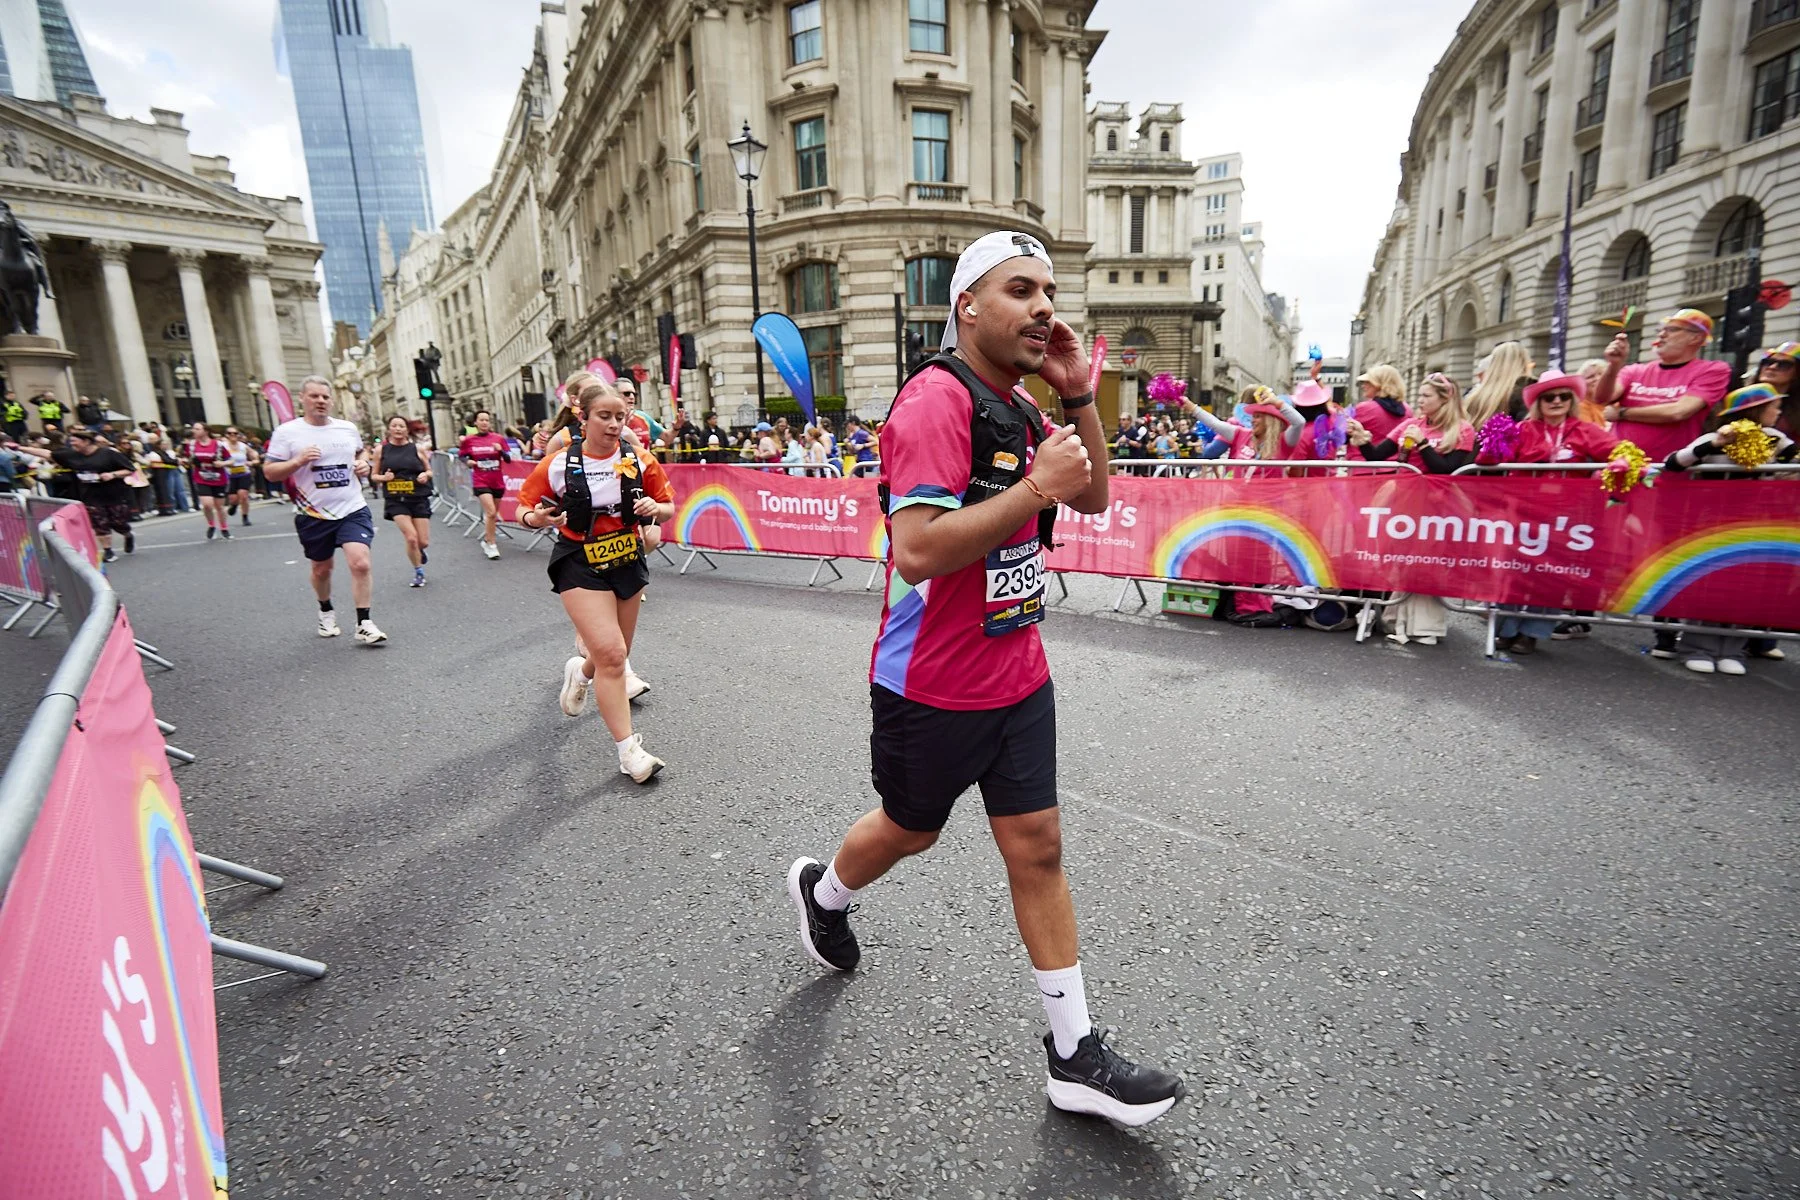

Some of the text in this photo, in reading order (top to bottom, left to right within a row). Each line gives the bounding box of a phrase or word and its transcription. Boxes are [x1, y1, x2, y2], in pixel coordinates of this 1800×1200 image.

[319, 471, 345, 480] 1005
[757, 490, 859, 521] Tommy's
[815, 522, 833, 533] baby
[833, 525, 858, 533] charity
[1360, 507, 1595, 556] Tommy's
[589, 537, 633, 559] 12404
[1061, 533, 1076, 541] and
[1079, 533, 1101, 546] baby
[1103, 536, 1136, 549] charity
[1356, 550, 1591, 578] The pregnancy and baby charity
